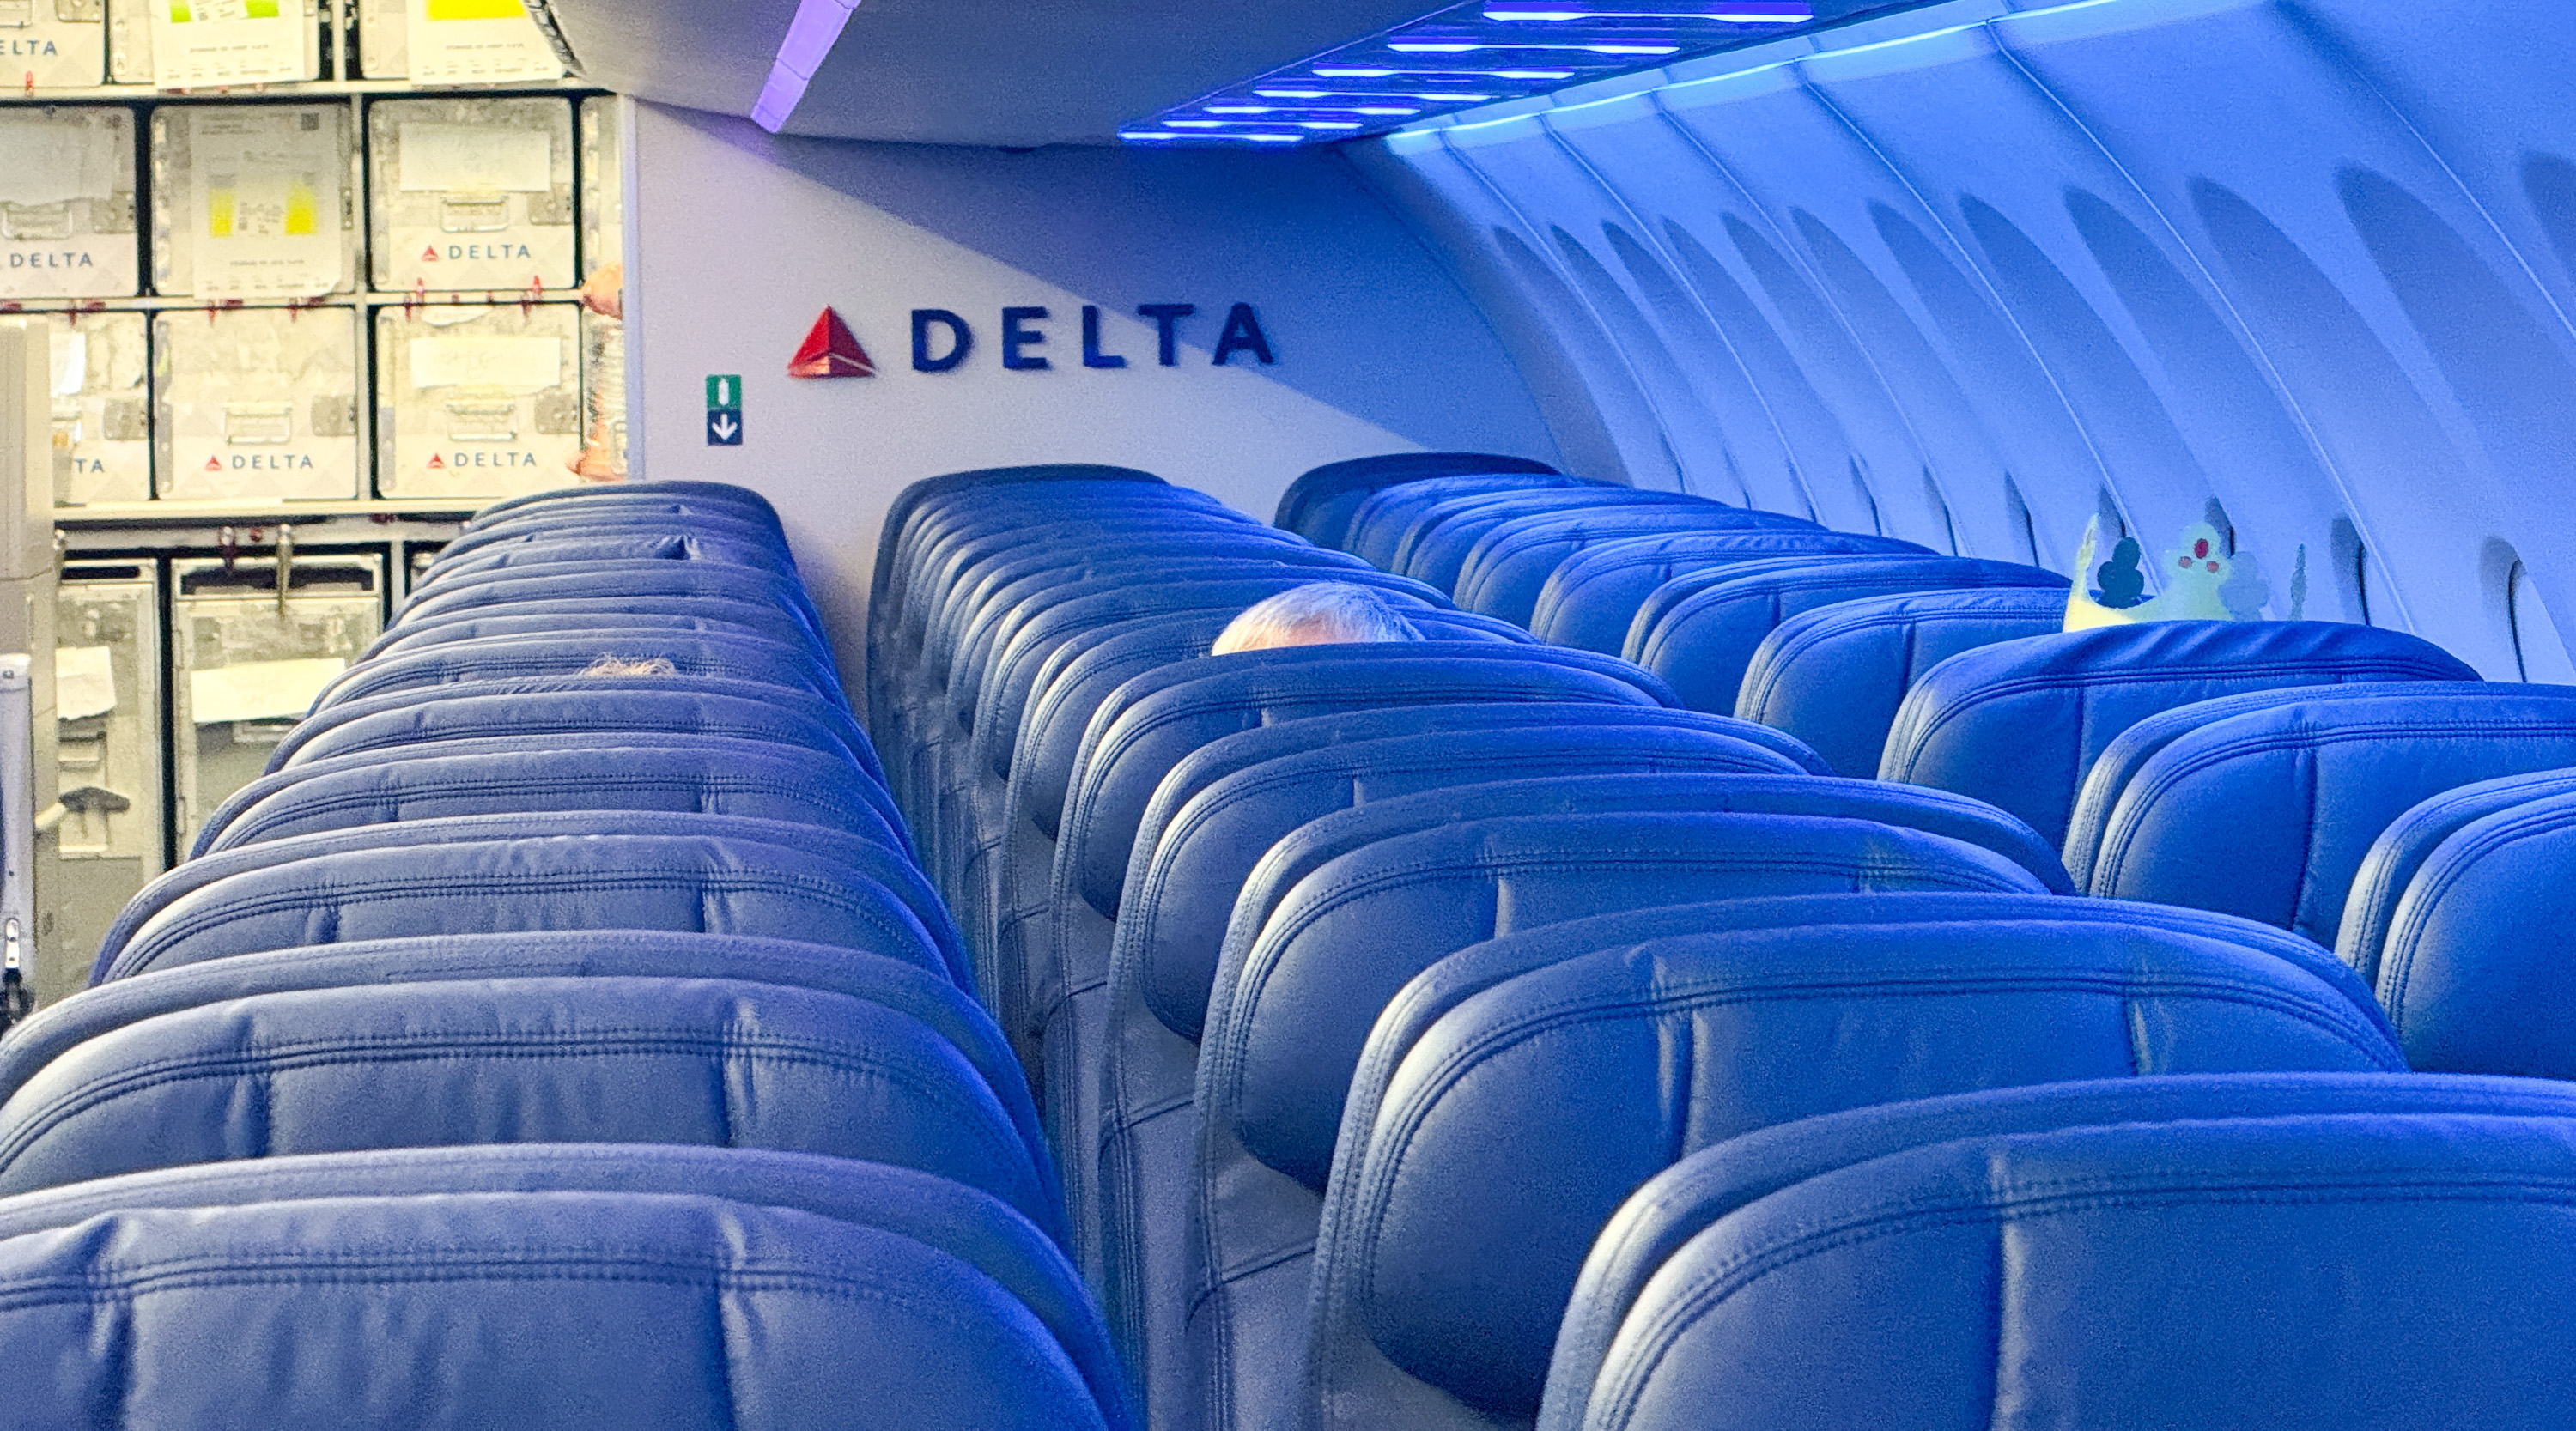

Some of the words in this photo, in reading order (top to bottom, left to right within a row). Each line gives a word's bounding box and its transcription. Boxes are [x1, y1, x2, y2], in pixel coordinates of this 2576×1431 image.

[448, 244, 532, 259] DELTA
[9, 252, 94, 268] DELTA
[911, 301, 1274, 373] DELTA
[232, 454, 313, 470] DELTA
[454, 452, 537, 467] DELTA
